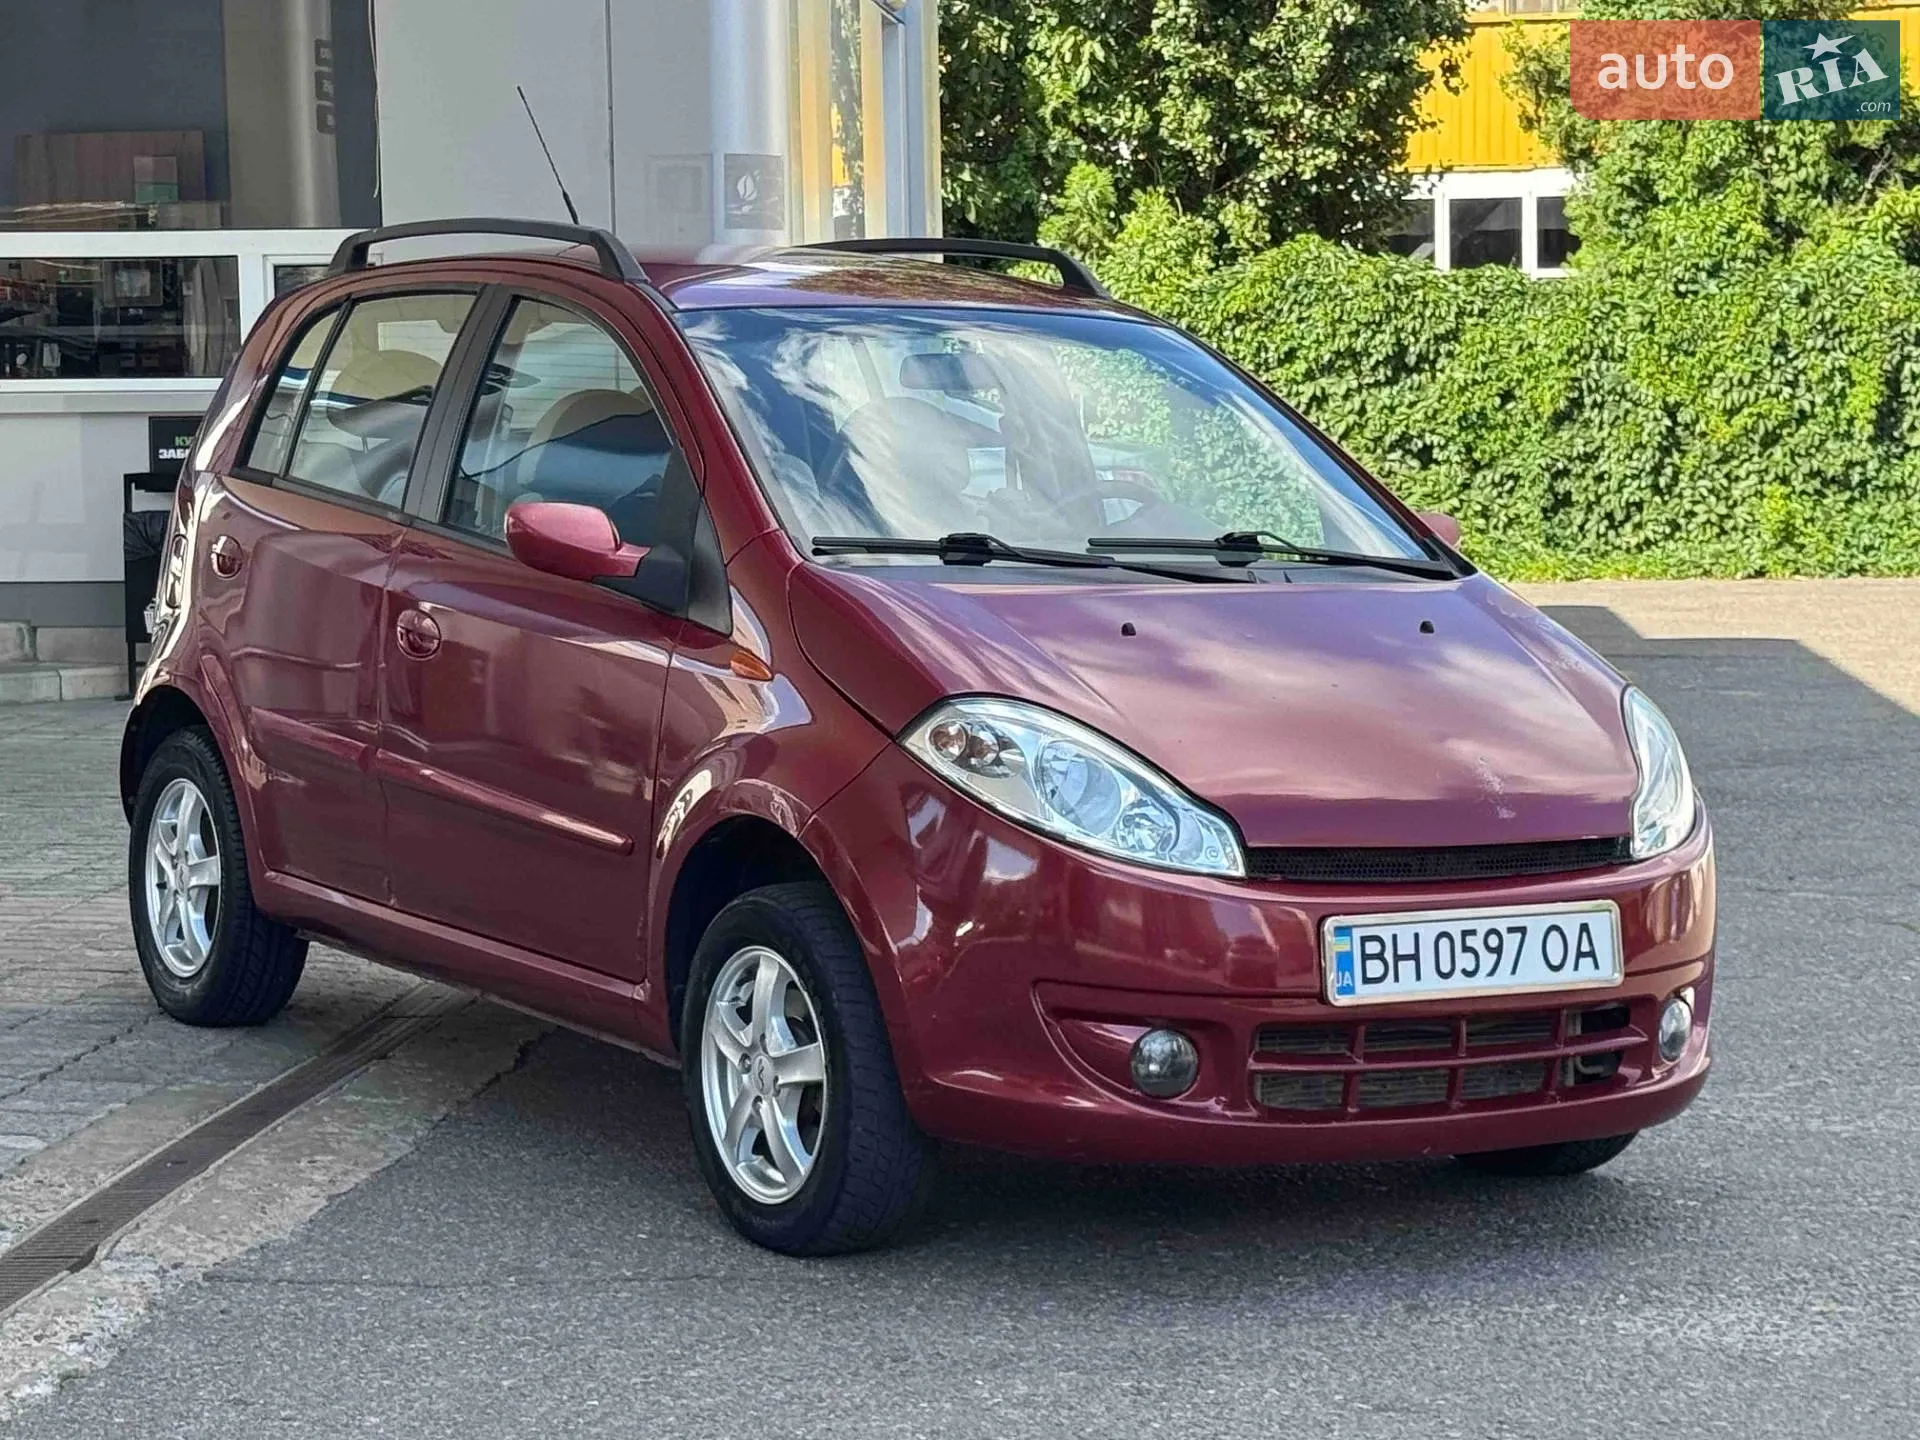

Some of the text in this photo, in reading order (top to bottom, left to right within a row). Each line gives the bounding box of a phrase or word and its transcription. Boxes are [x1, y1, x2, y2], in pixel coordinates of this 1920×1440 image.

[175, 436, 194, 446] КУ
[1360, 922, 1600, 985] BH 0597 OA
